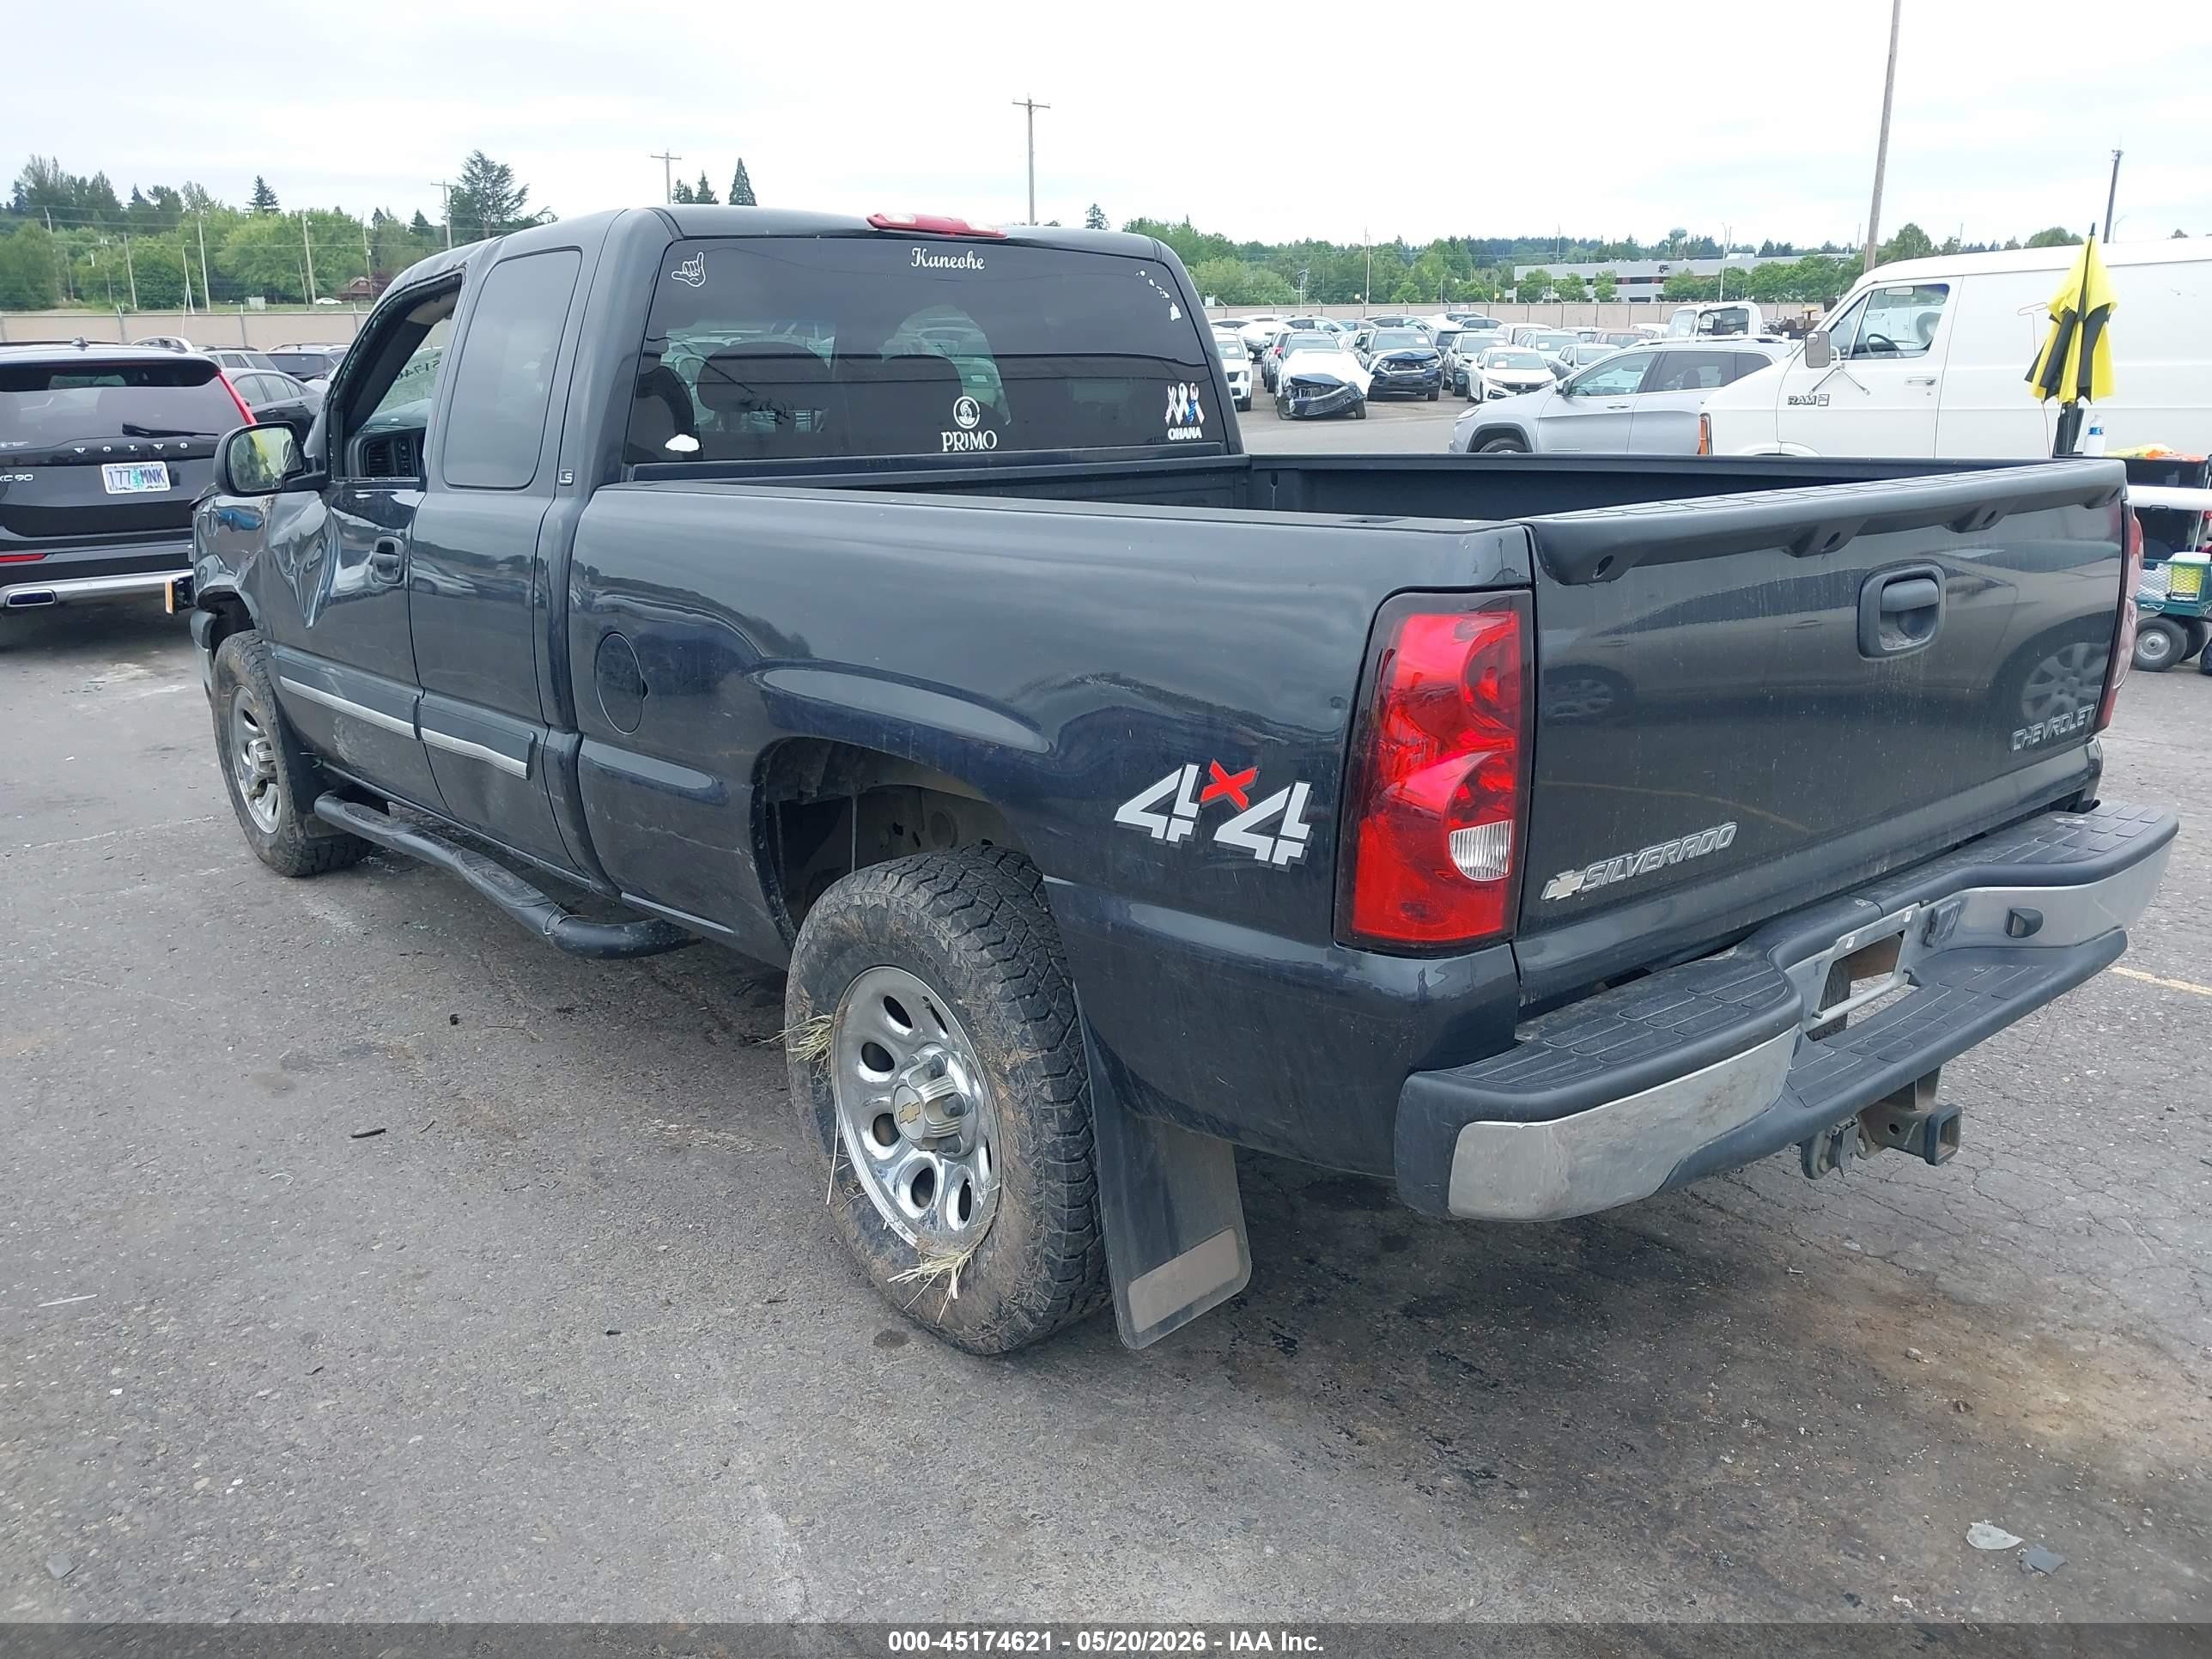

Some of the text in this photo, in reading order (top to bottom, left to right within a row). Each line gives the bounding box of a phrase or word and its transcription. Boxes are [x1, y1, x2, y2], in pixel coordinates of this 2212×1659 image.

[1788, 395, 1817, 405] RAM
[1168, 427, 1202, 440] OHANA
[74, 442, 188, 454] VOLVO
[941, 430, 997, 452] PRIMO
[140, 468, 166, 484] MNK
[559, 473, 573, 483] LS
[2012, 704, 2095, 750] CHEVROLET
[1581, 822, 1738, 892] SILVERADO
